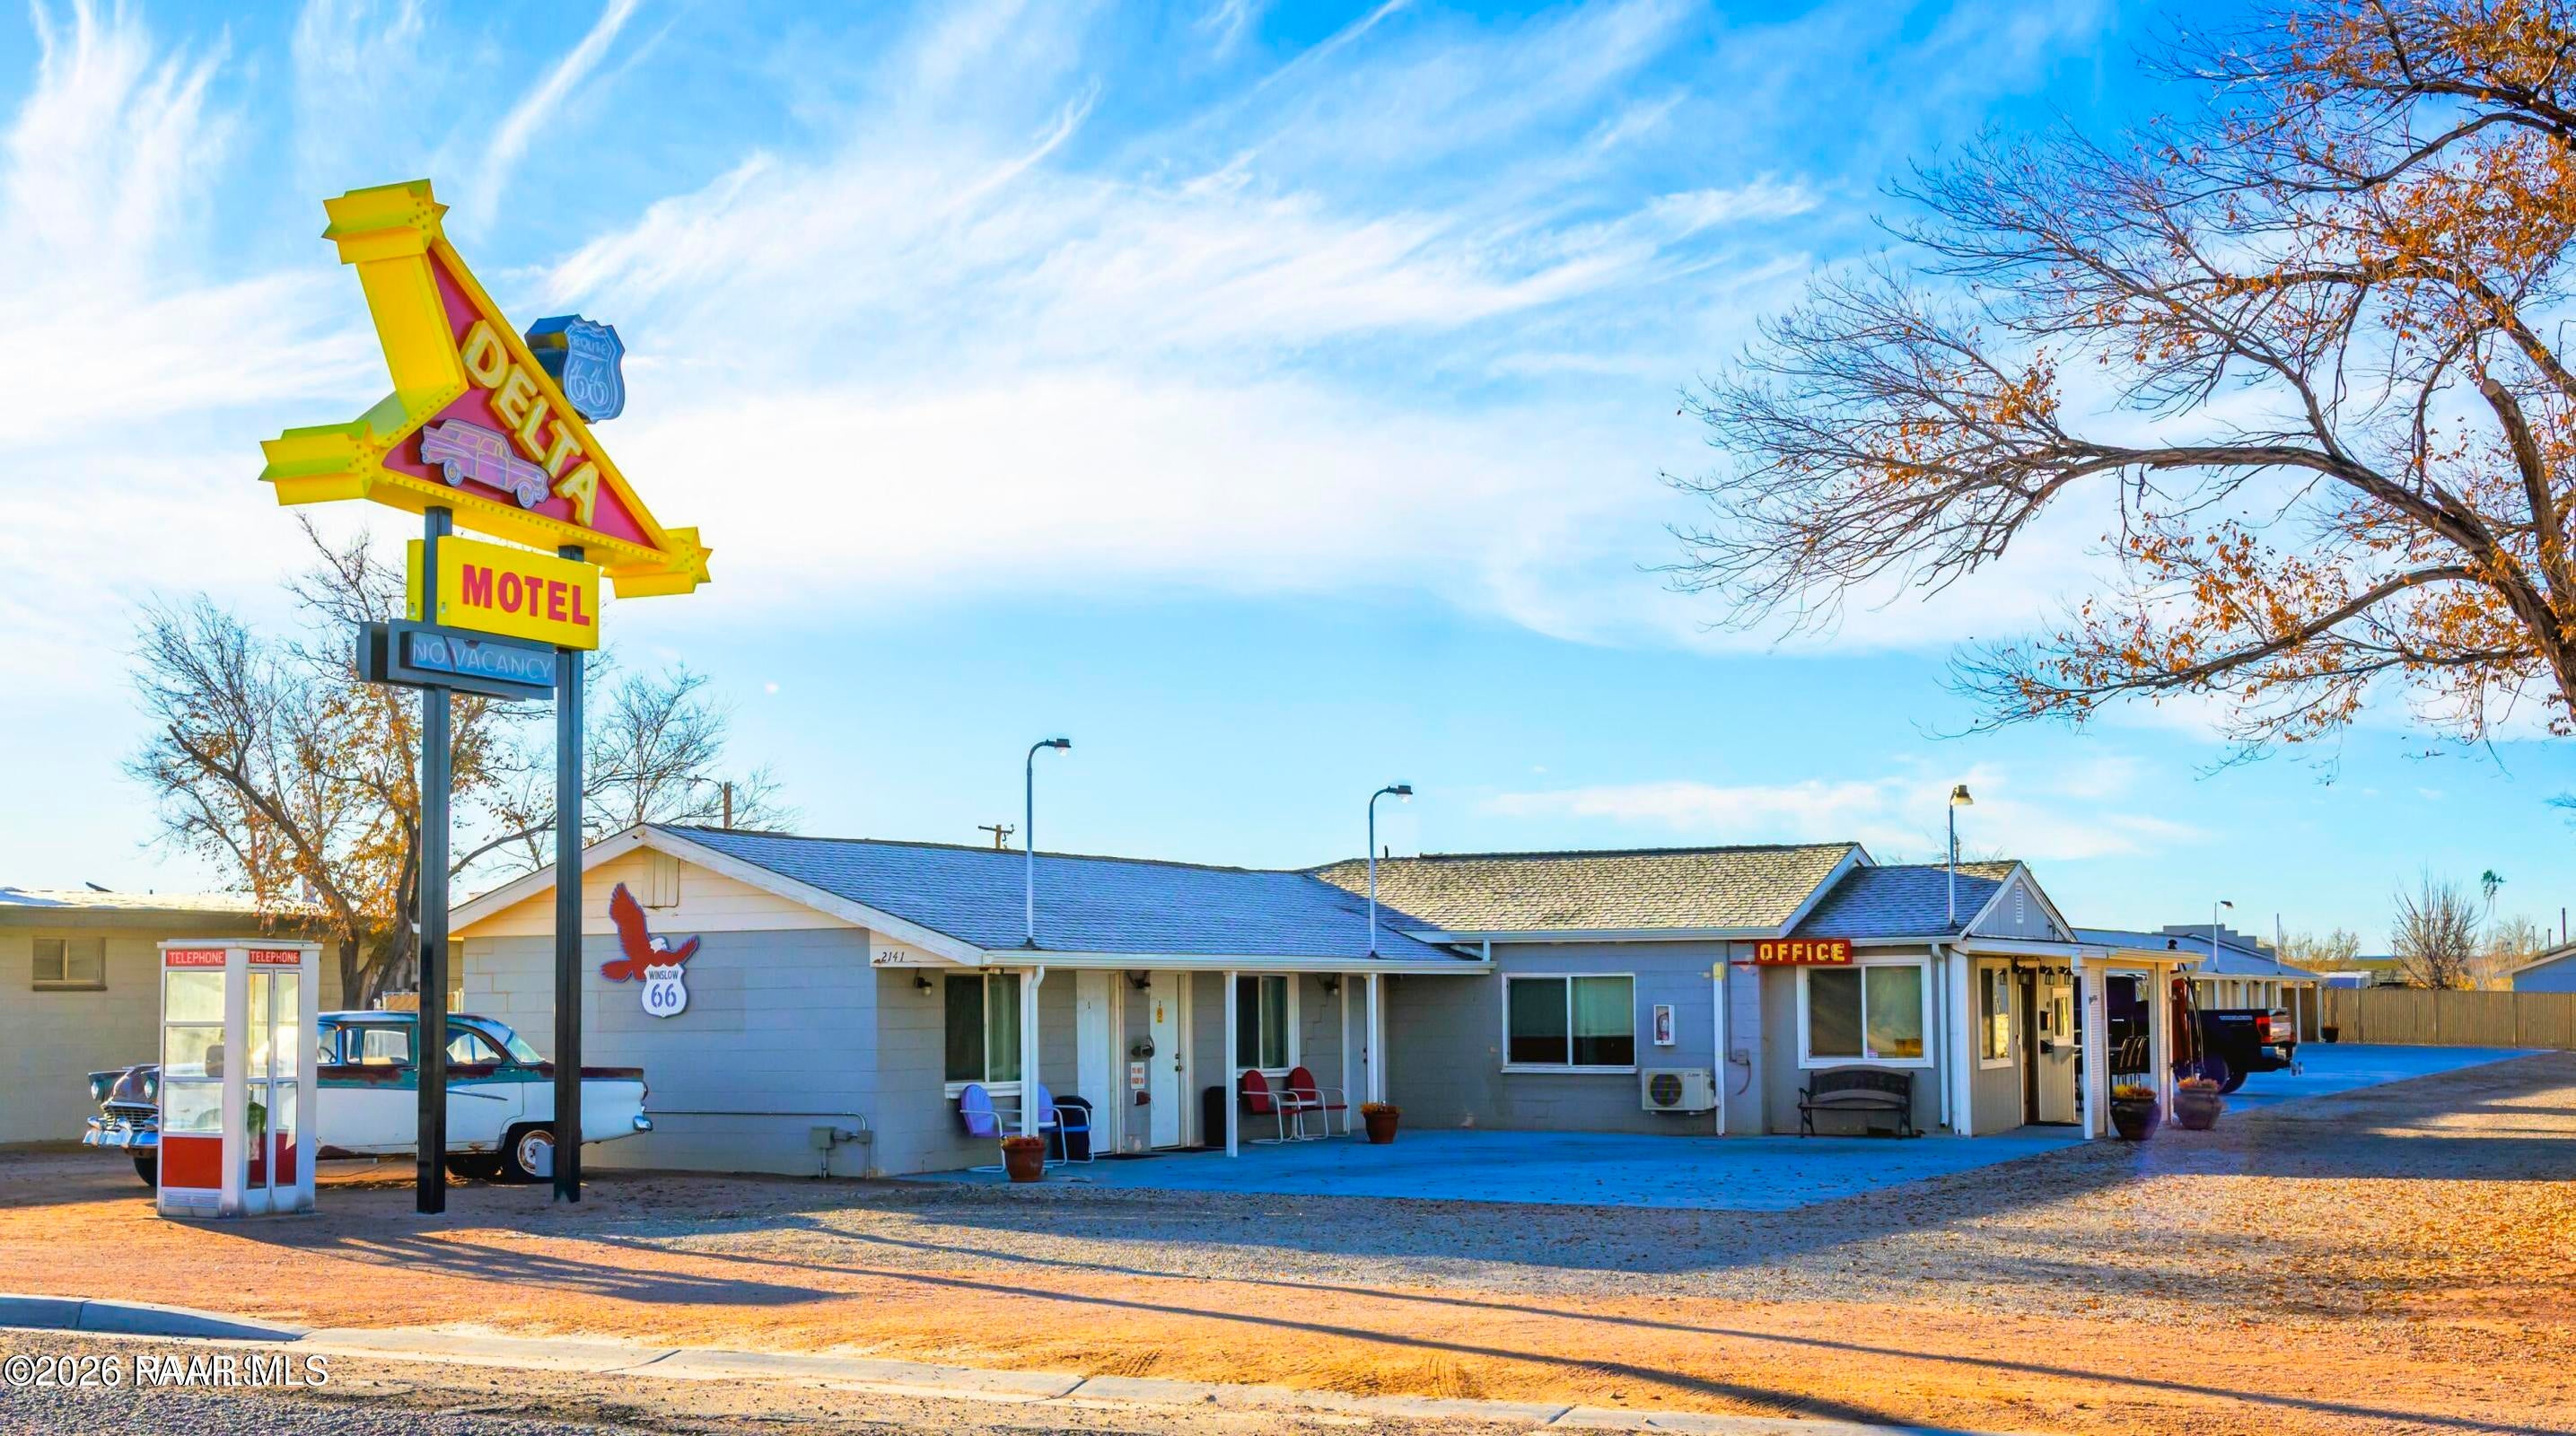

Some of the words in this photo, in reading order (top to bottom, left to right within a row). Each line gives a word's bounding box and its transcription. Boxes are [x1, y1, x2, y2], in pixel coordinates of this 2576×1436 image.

[571, 335, 608, 355] ROUTE
[569, 359, 609, 407] 66
[460, 319, 600, 528] DELTA
[462, 564, 590, 626] MOTEL
[413, 641, 447, 666] NO
[452, 646, 551, 679] VACANCY
[170, 951, 224, 964] TELEPHONE
[250, 950, 299, 963] TELEPHONE
[881, 951, 905, 962] 2141
[1760, 943, 1844, 961] OFFICE
[649, 969, 679, 980] WINSLOW
[651, 983, 677, 1008] 66
